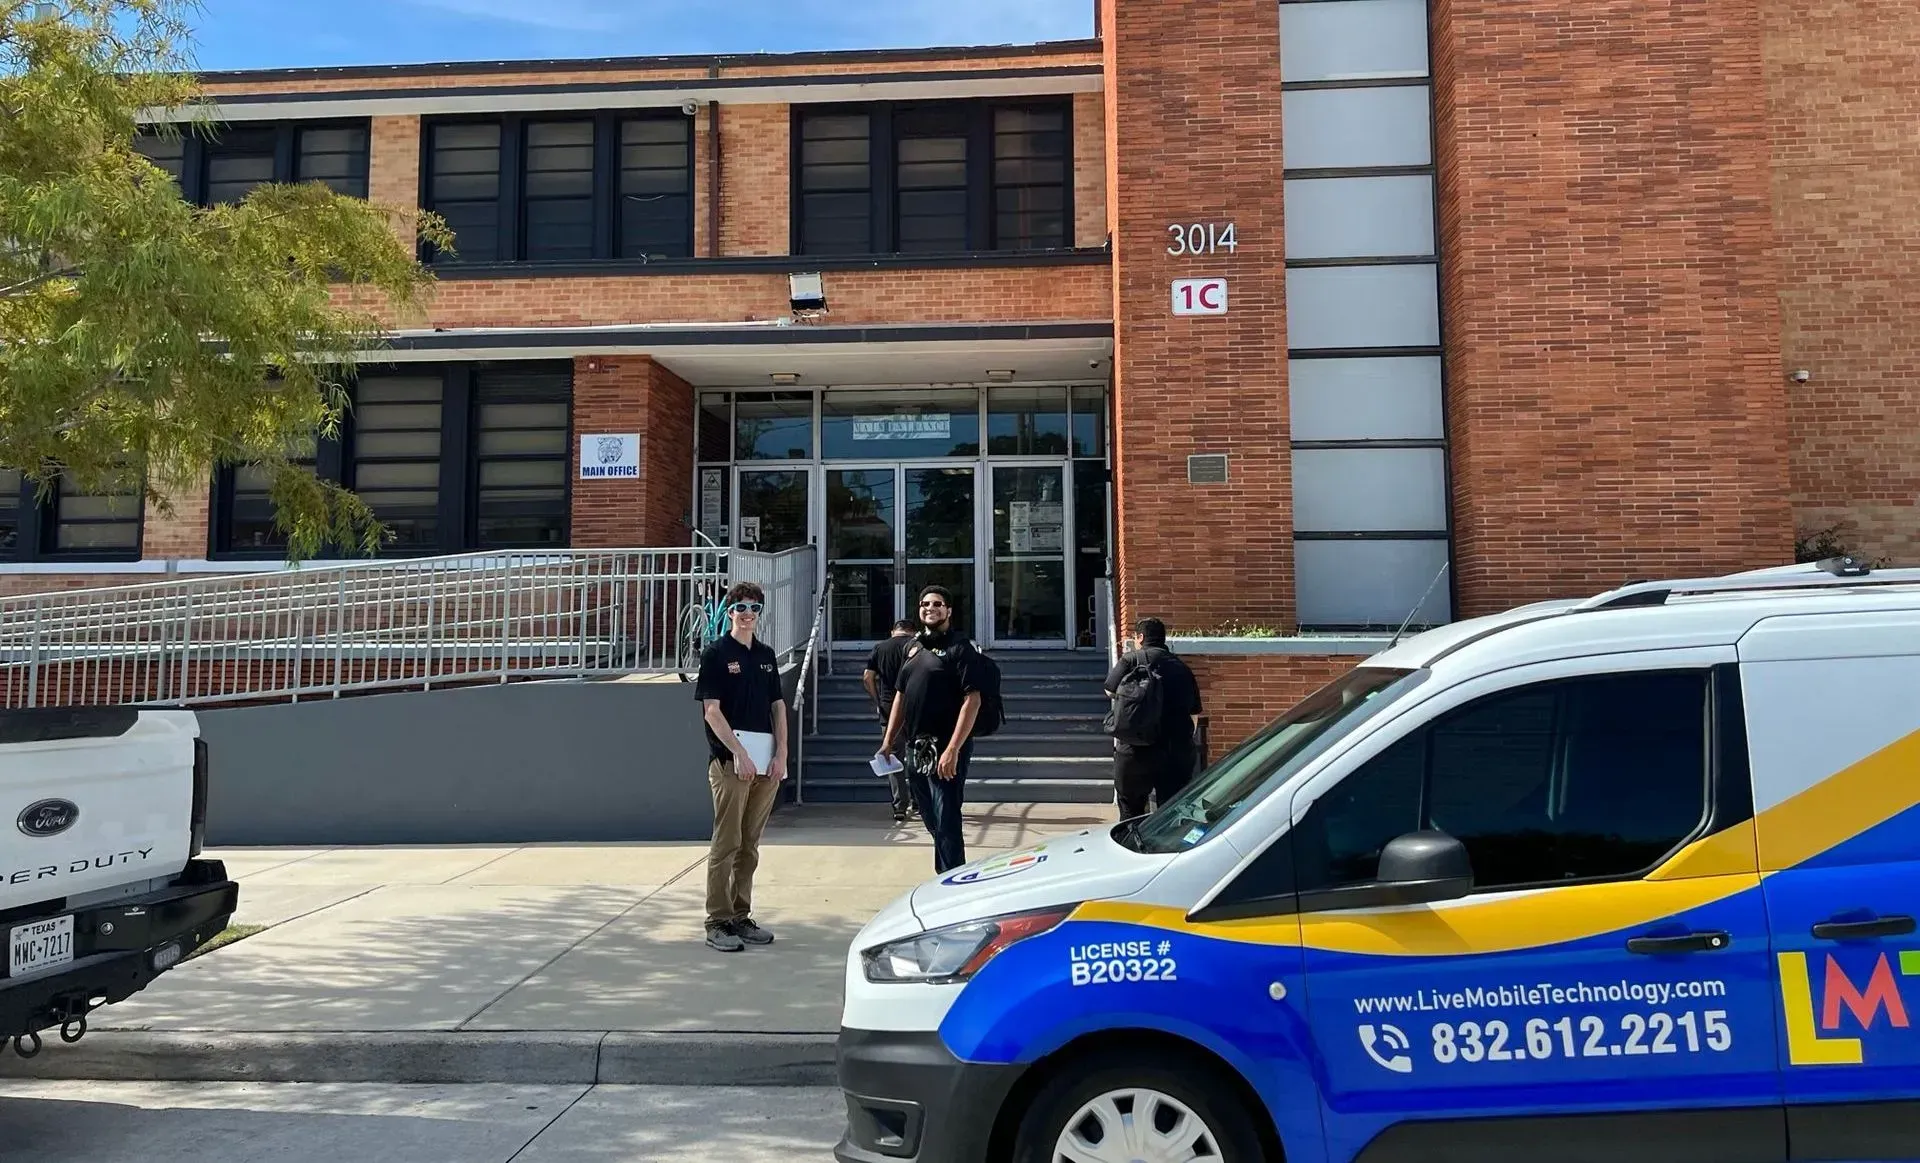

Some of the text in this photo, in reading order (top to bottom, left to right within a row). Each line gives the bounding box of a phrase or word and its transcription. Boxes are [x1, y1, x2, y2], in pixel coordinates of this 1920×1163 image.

[1167, 222, 1238, 256] 3014
[1180, 283, 1219, 310] 1C
[582, 465, 637, 477] MAIN OFFICE
[35, 806, 67, 829] Ford
[0, 847, 153, 885] ER DUTY
[32, 921, 56, 936] TEXAS
[1070, 940, 1171, 962] LICENSE #
[1071, 958, 1177, 986] B20322
[1353, 976, 1726, 1015] www.LiveMobileTechnology.com
[1431, 1010, 1732, 1064] 832.612.2215
